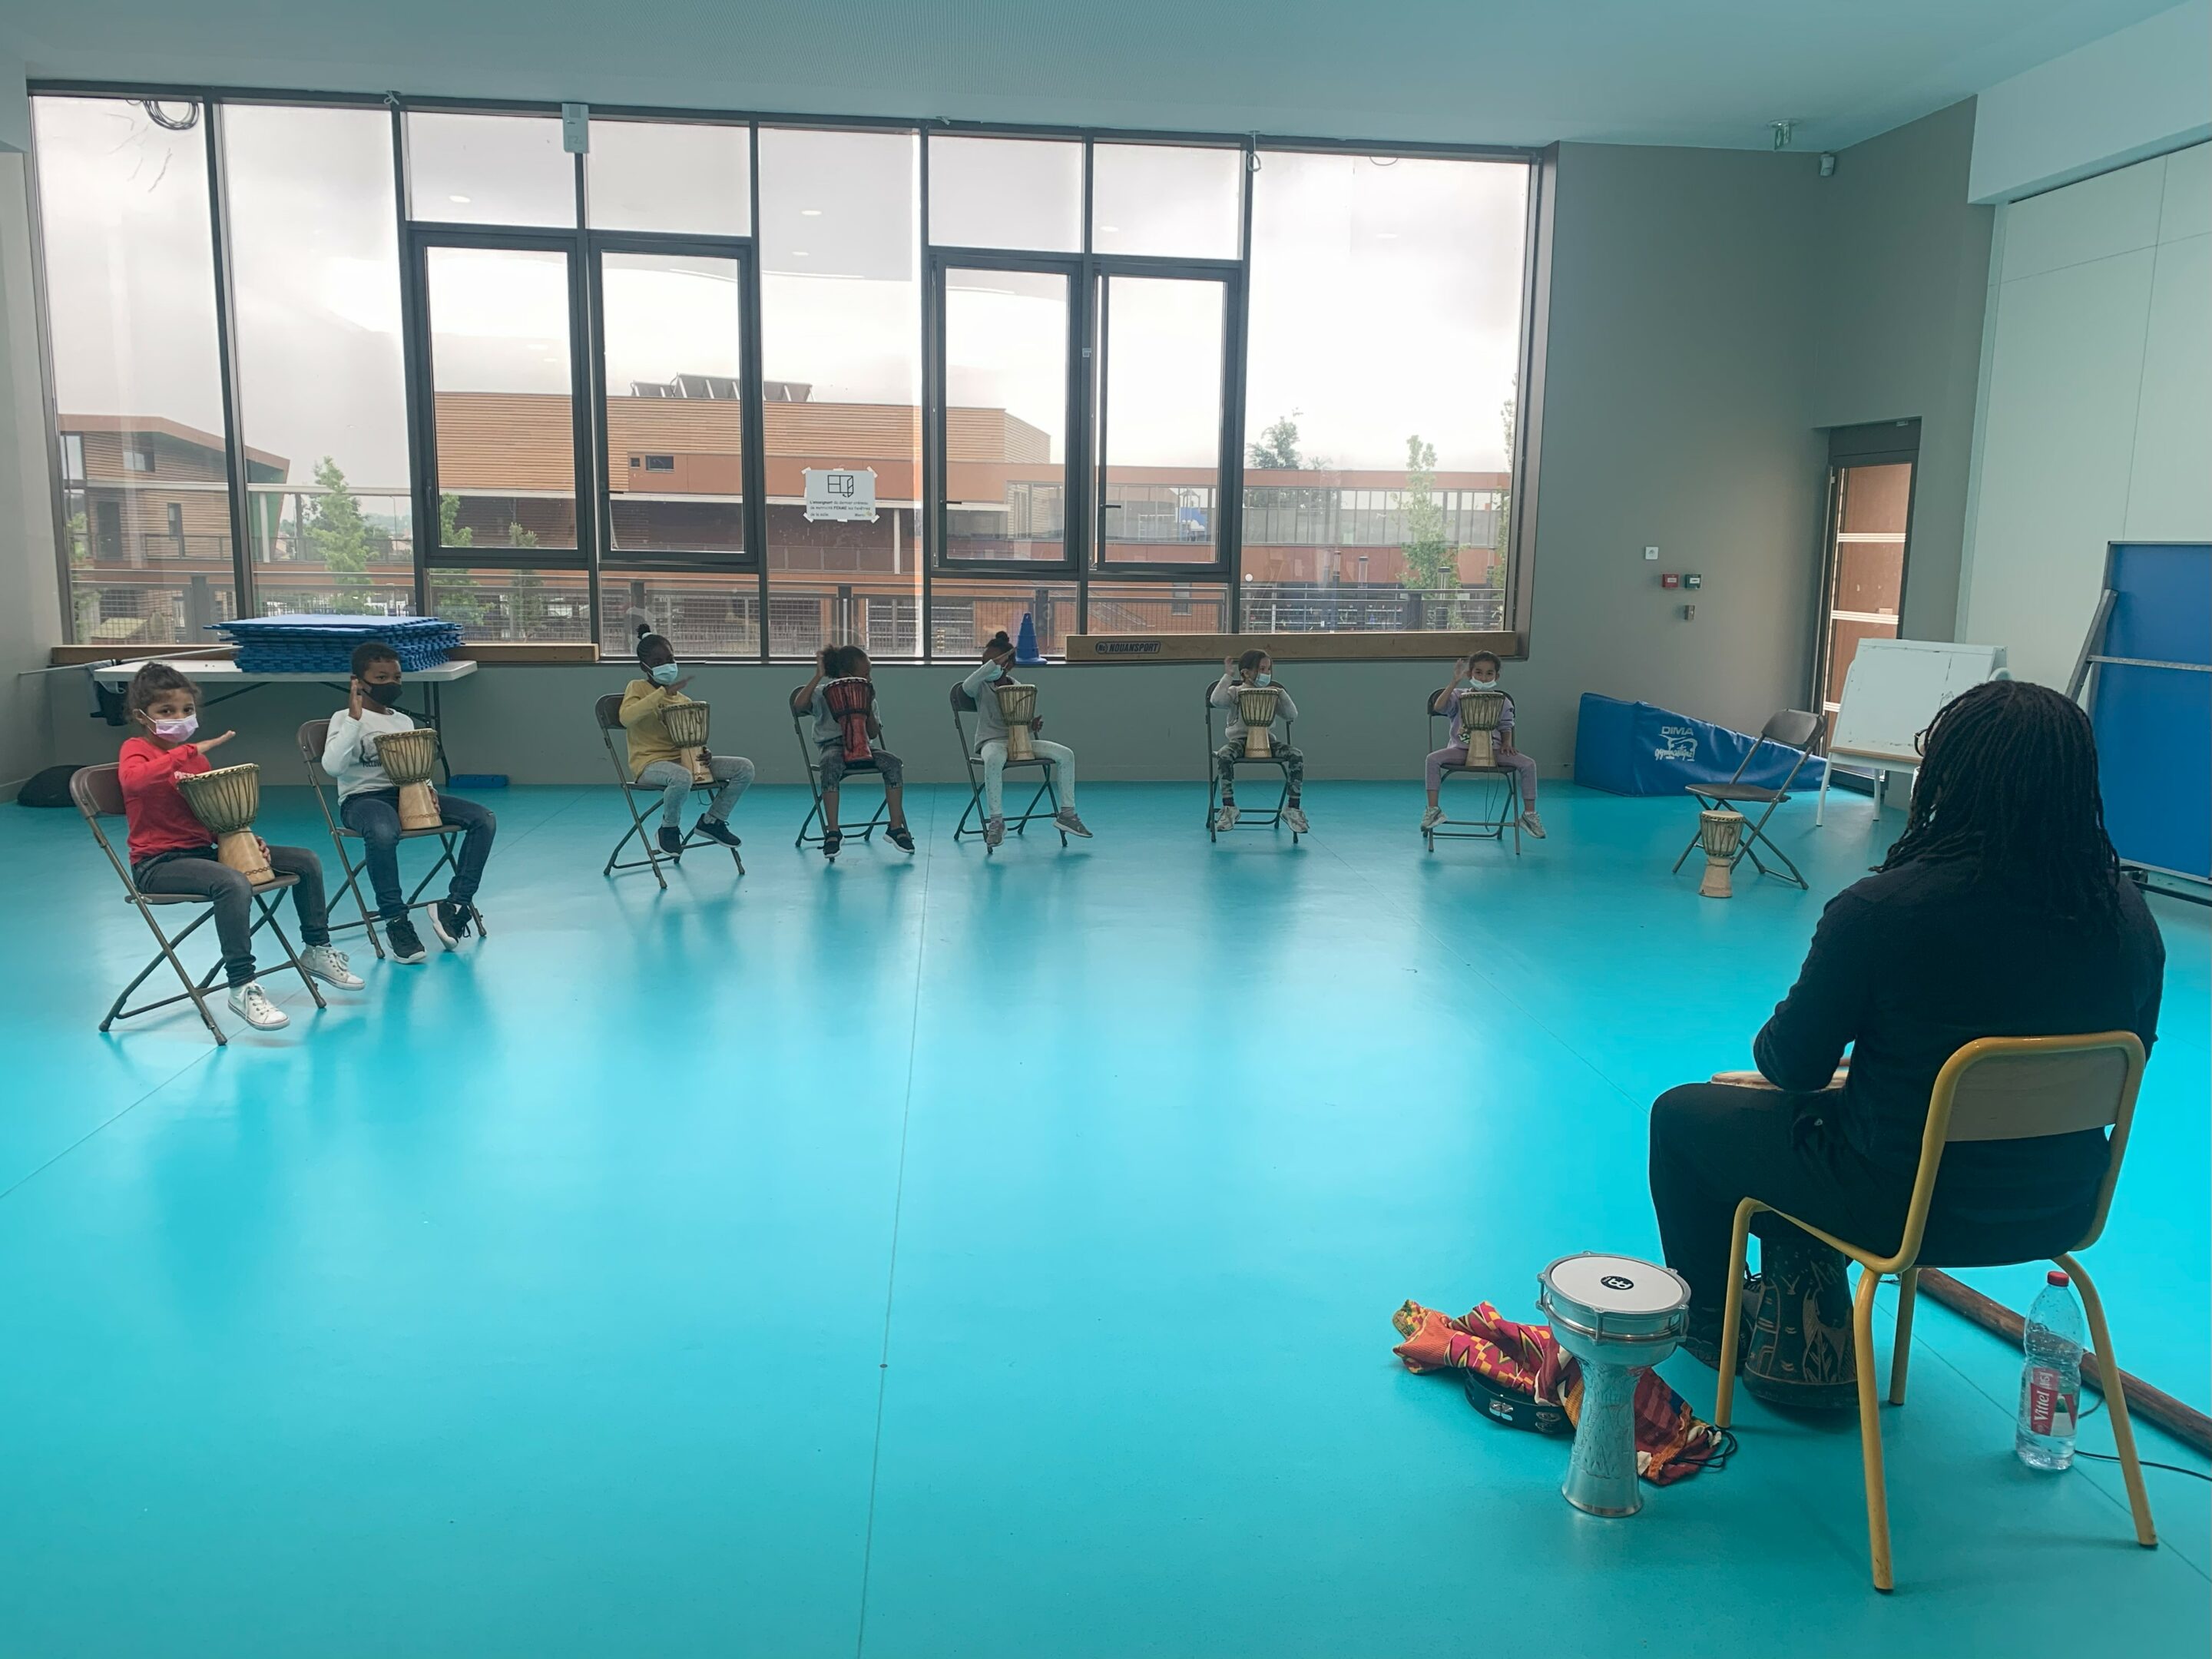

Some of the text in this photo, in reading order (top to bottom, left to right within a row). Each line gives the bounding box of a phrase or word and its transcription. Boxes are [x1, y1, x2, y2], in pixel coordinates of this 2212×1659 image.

[1109, 643, 1159, 652] NOUANSPORT
[1661, 726, 1694, 736] DIMA
[2034, 1389, 2050, 1421] Vittel
